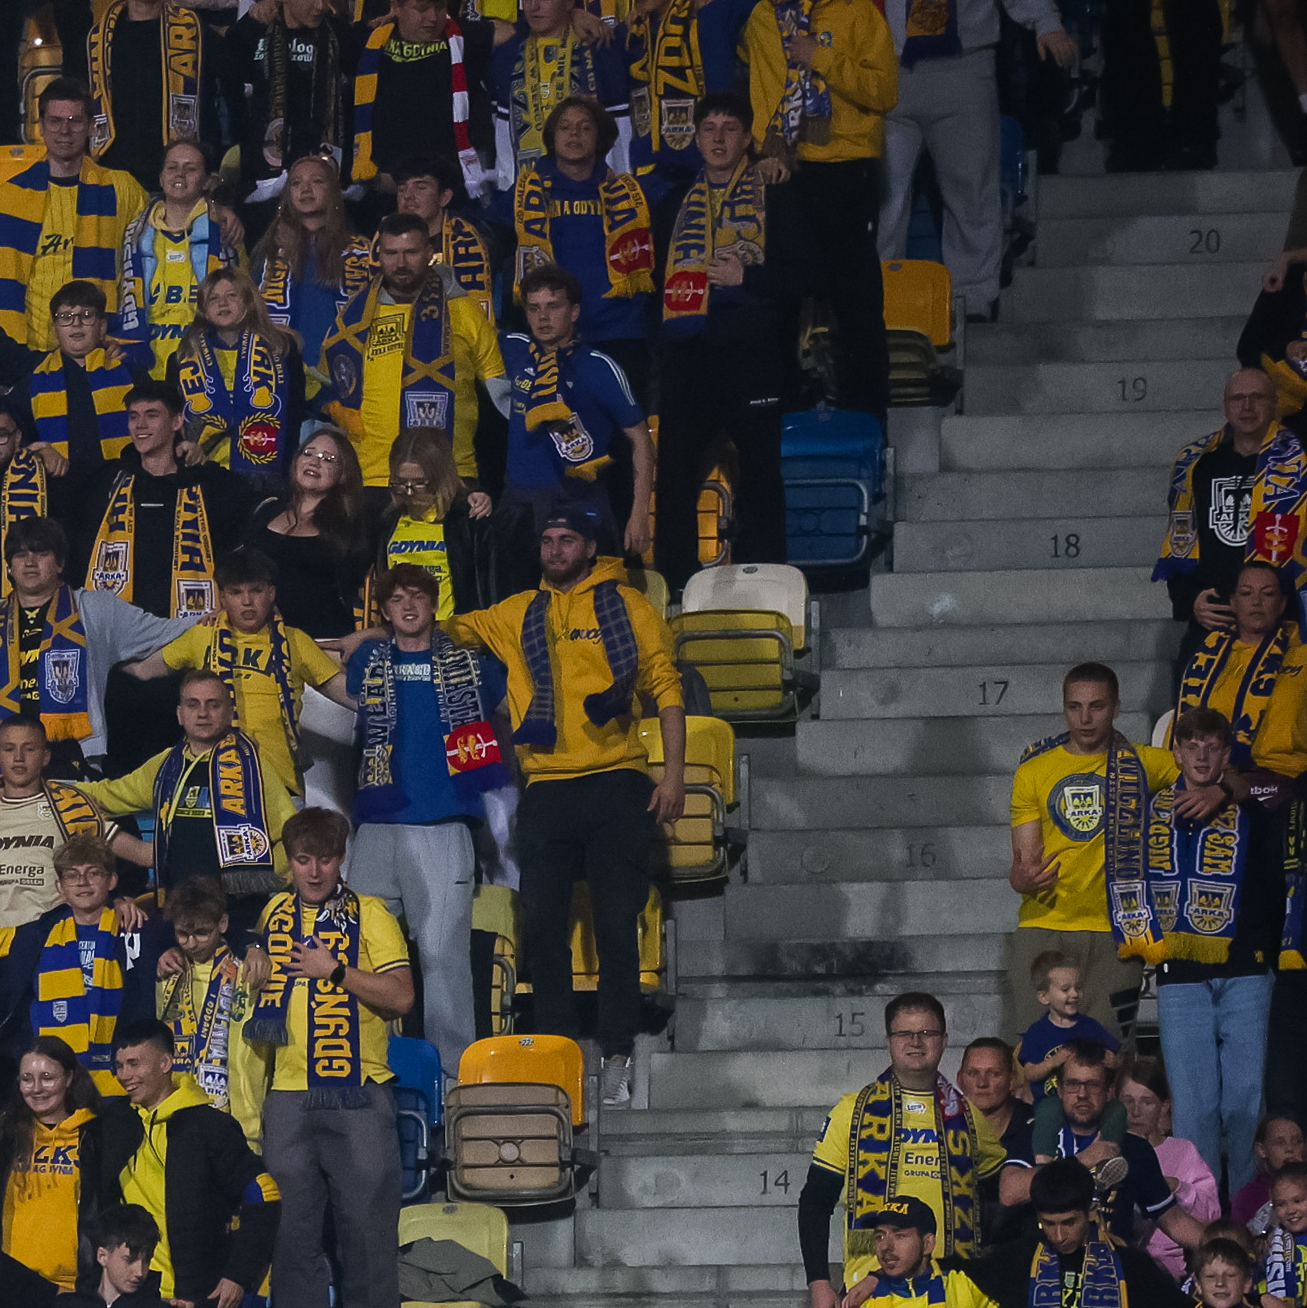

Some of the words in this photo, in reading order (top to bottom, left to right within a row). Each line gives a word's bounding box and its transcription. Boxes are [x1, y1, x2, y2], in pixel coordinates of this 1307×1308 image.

[167, 7, 199, 82] ARK
[38, 233, 74, 254] Ar
[1190, 230, 1221, 254] 20
[1118, 378, 1148, 402] 19
[564, 438, 587, 451] ARKA
[388, 539, 445, 554] GDYNIA
[1051, 534, 1081, 558] 18
[97, 570, 127, 584] ARKA
[979, 682, 1008, 705] 17
[1068, 807, 1101, 818] ARKA
[240, 830, 252, 864] ARKA
[1202, 830, 1237, 875] SAM
[1190, 908, 1227, 919] ARKA
[316, 929, 351, 1077] GDYŃSY
[835, 1013, 865, 1036] 15
[900, 1129, 940, 1143] DYN
[859, 1080, 890, 1216] ARKA
[905, 1152, 940, 1166] Ener
[760, 1171, 790, 1194] 14
[904, 1170, 931, 1178] GRUPA
